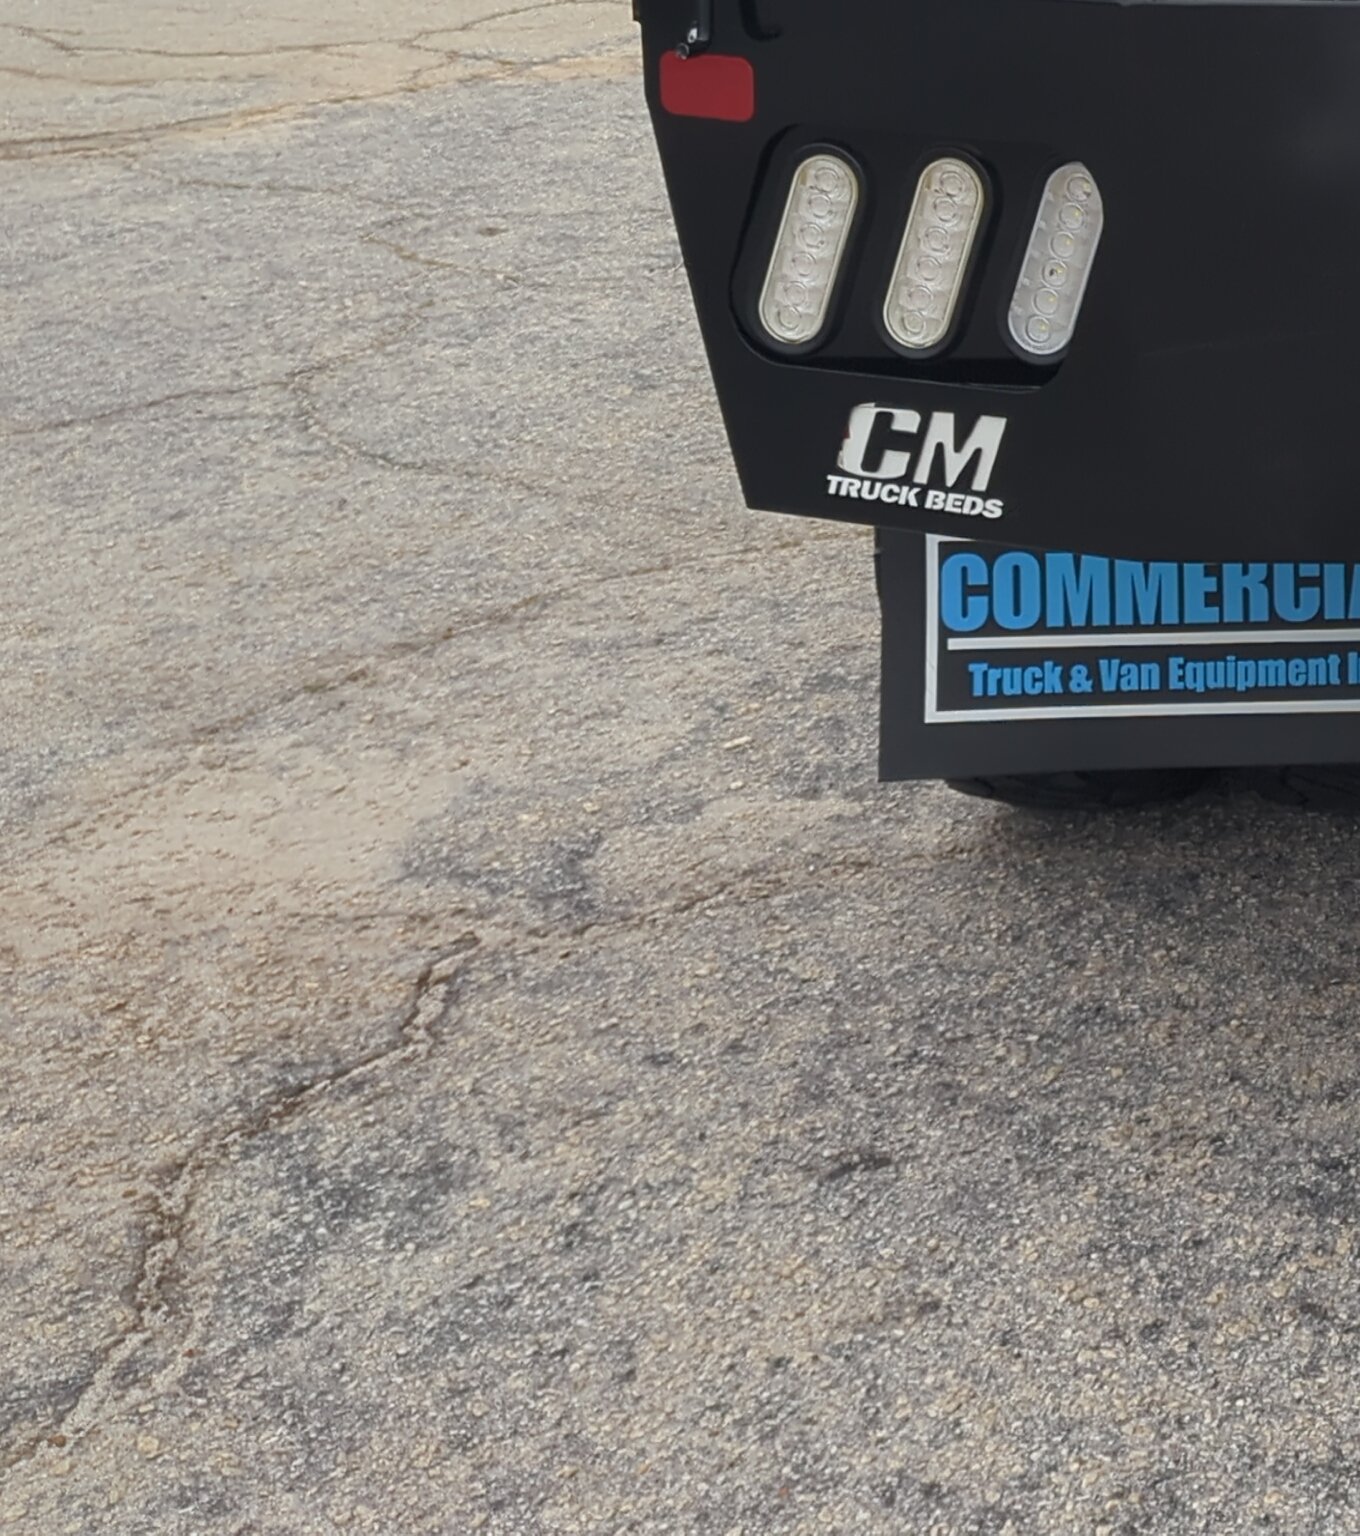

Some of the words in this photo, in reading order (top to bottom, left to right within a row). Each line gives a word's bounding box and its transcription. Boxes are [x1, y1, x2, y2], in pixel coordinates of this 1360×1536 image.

[837, 402, 1008, 492] CM
[826, 474, 921, 507] TRUCK
[924, 489, 1004, 519] BEDS
[968, 661, 1063, 697] Truck
[1069, 664, 1093, 693] &
[1099, 659, 1160, 693] Van
[1168, 653, 1341, 693] Equipment
